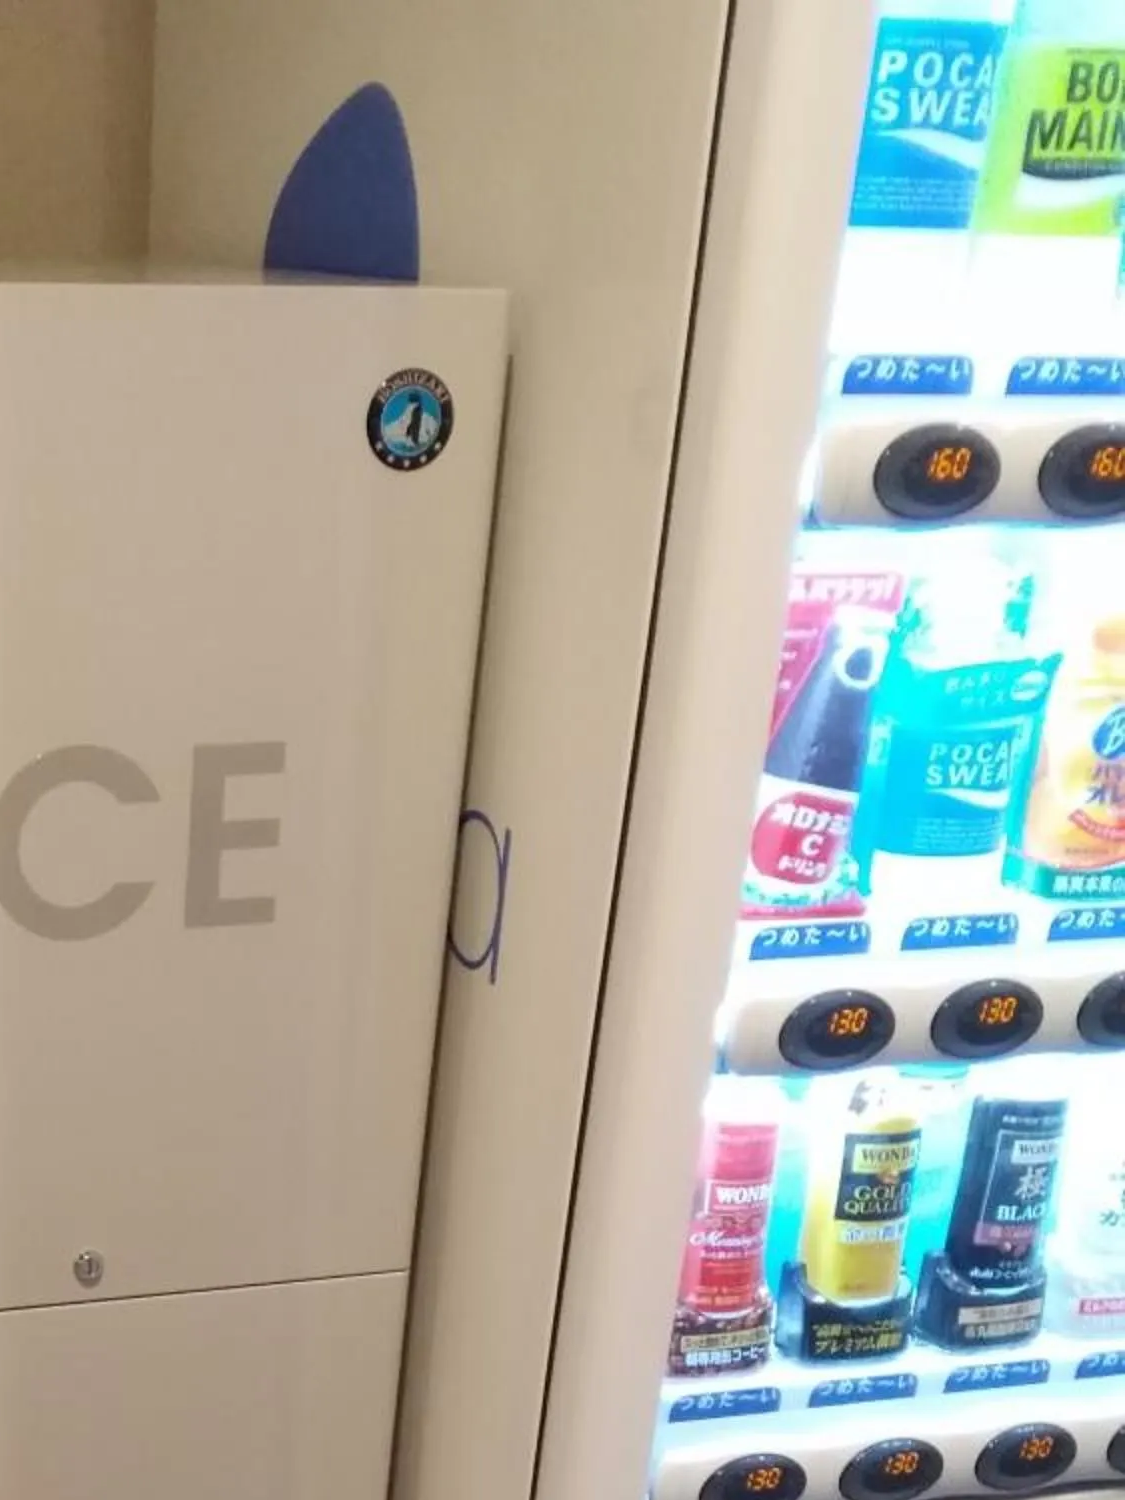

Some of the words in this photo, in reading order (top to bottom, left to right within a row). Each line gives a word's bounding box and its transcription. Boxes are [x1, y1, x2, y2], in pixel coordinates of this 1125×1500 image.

[1066, 60, 1125, 104] BO
[928, 448, 972, 480] 160
[829, 1007, 869, 1035] 130
[979, 997, 1018, 1025] 130
[1019, 1436, 1054, 1461] 130
[885, 1451, 920, 1476] 130
[746, 1467, 782, 1492] 130
